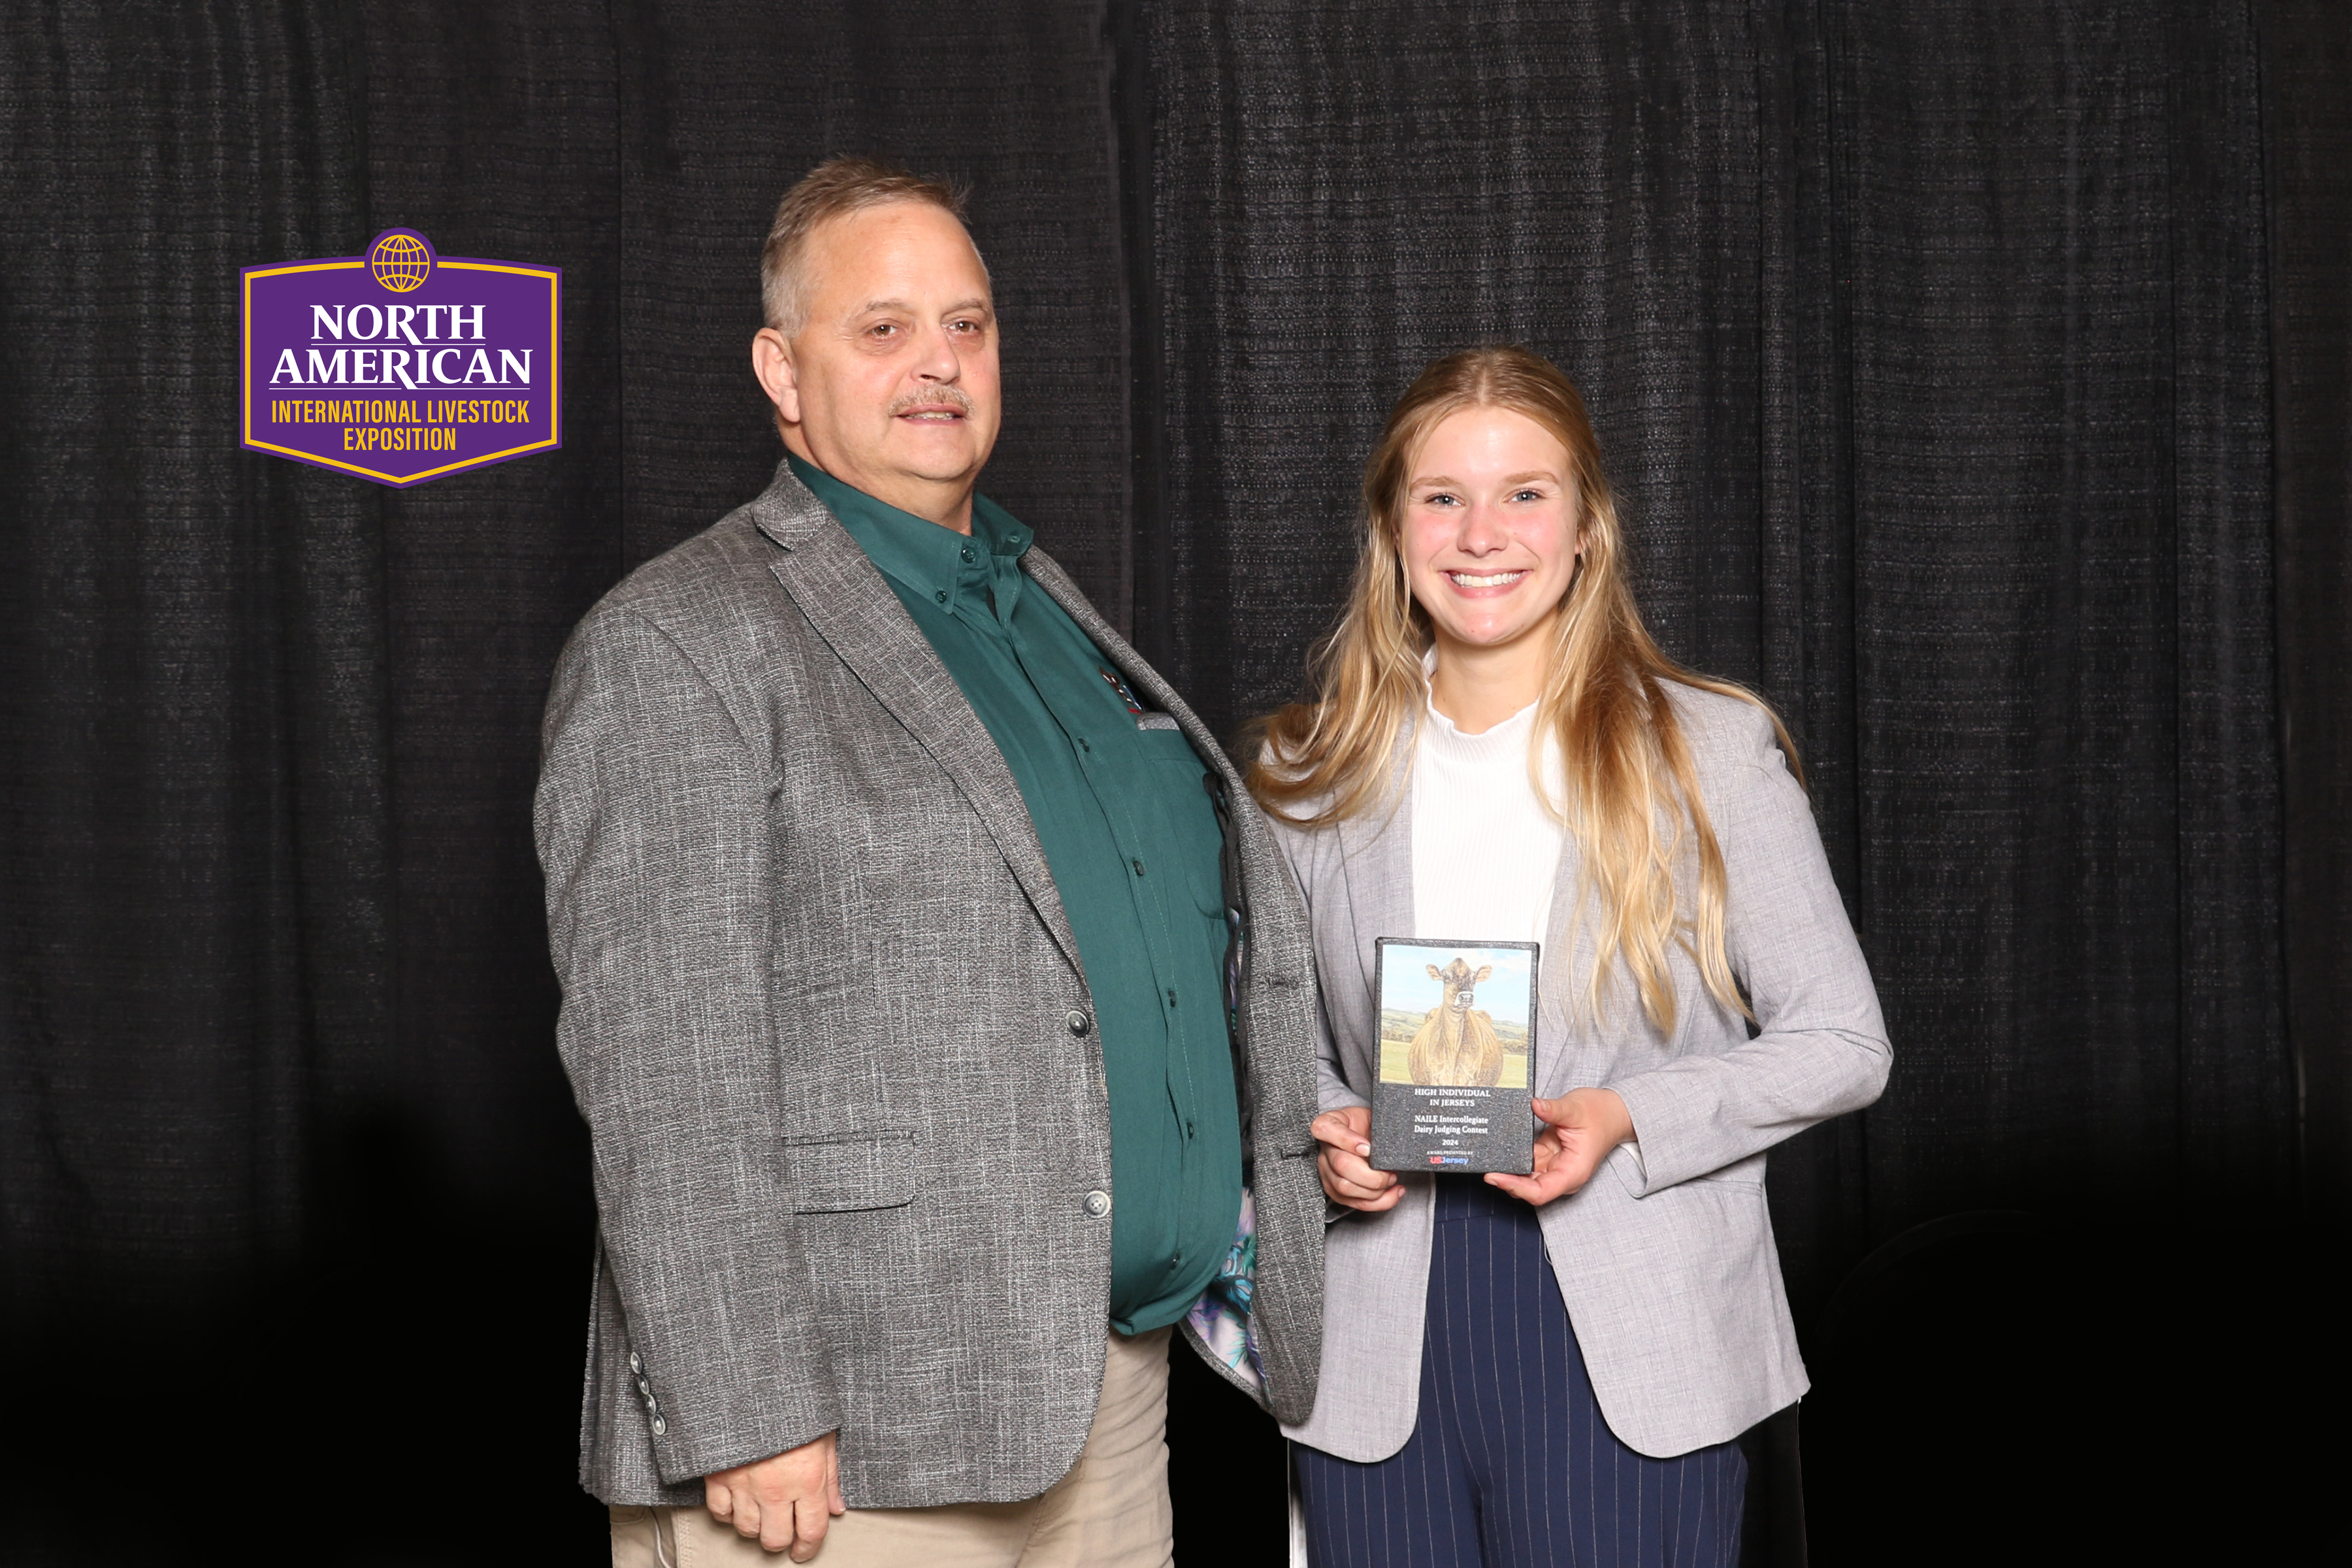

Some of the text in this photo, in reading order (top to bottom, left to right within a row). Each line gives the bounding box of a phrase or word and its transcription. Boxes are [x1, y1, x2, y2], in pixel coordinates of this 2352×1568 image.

[1414, 1115, 1489, 1124] NAILE Intercollegiate
[1414, 1126, 1433, 1134] Dairy
[1434, 1126, 1461, 1134] Judging
